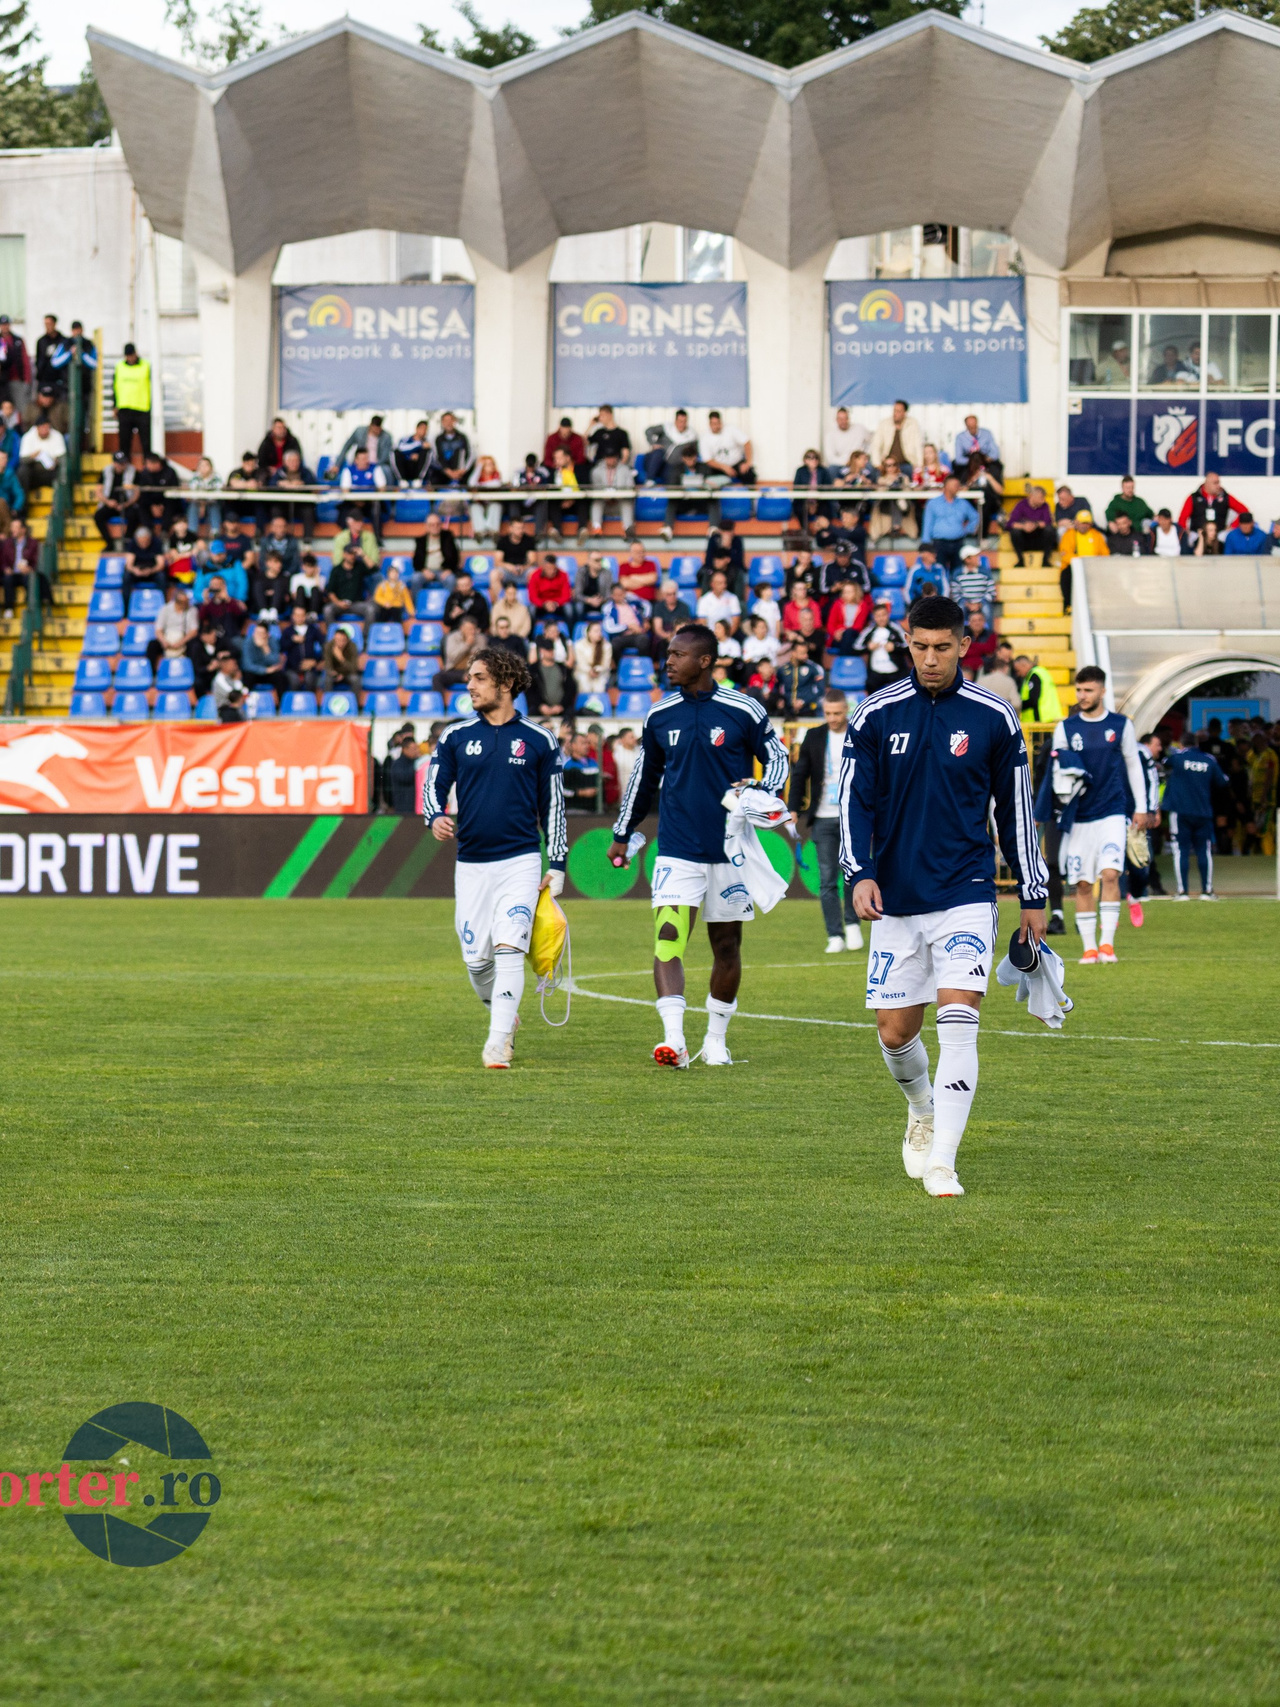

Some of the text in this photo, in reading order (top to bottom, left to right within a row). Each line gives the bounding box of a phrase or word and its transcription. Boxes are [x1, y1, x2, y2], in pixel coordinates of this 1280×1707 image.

[284, 294, 470, 341] CORNISA
[558, 292, 746, 339] CORNISA
[833, 289, 1024, 334] CORNISA
[283, 343, 471, 362] aquapark & sports
[558, 341, 747, 358] aquapark & sports
[833, 335, 1025, 357] aquapark & sports
[1217, 418, 1276, 458] FC
[465, 740, 483, 756] 66
[668, 730, 681, 746] 17
[889, 733, 910, 754] 27
[508, 757, 526, 765] FCBT
[1184, 760, 1209, 773] FCBT
[135, 756, 354, 809] Vestra
[654, 867, 672, 891] 17
[869, 951, 894, 985] 27
[881, 991, 906, 999] Vestra
